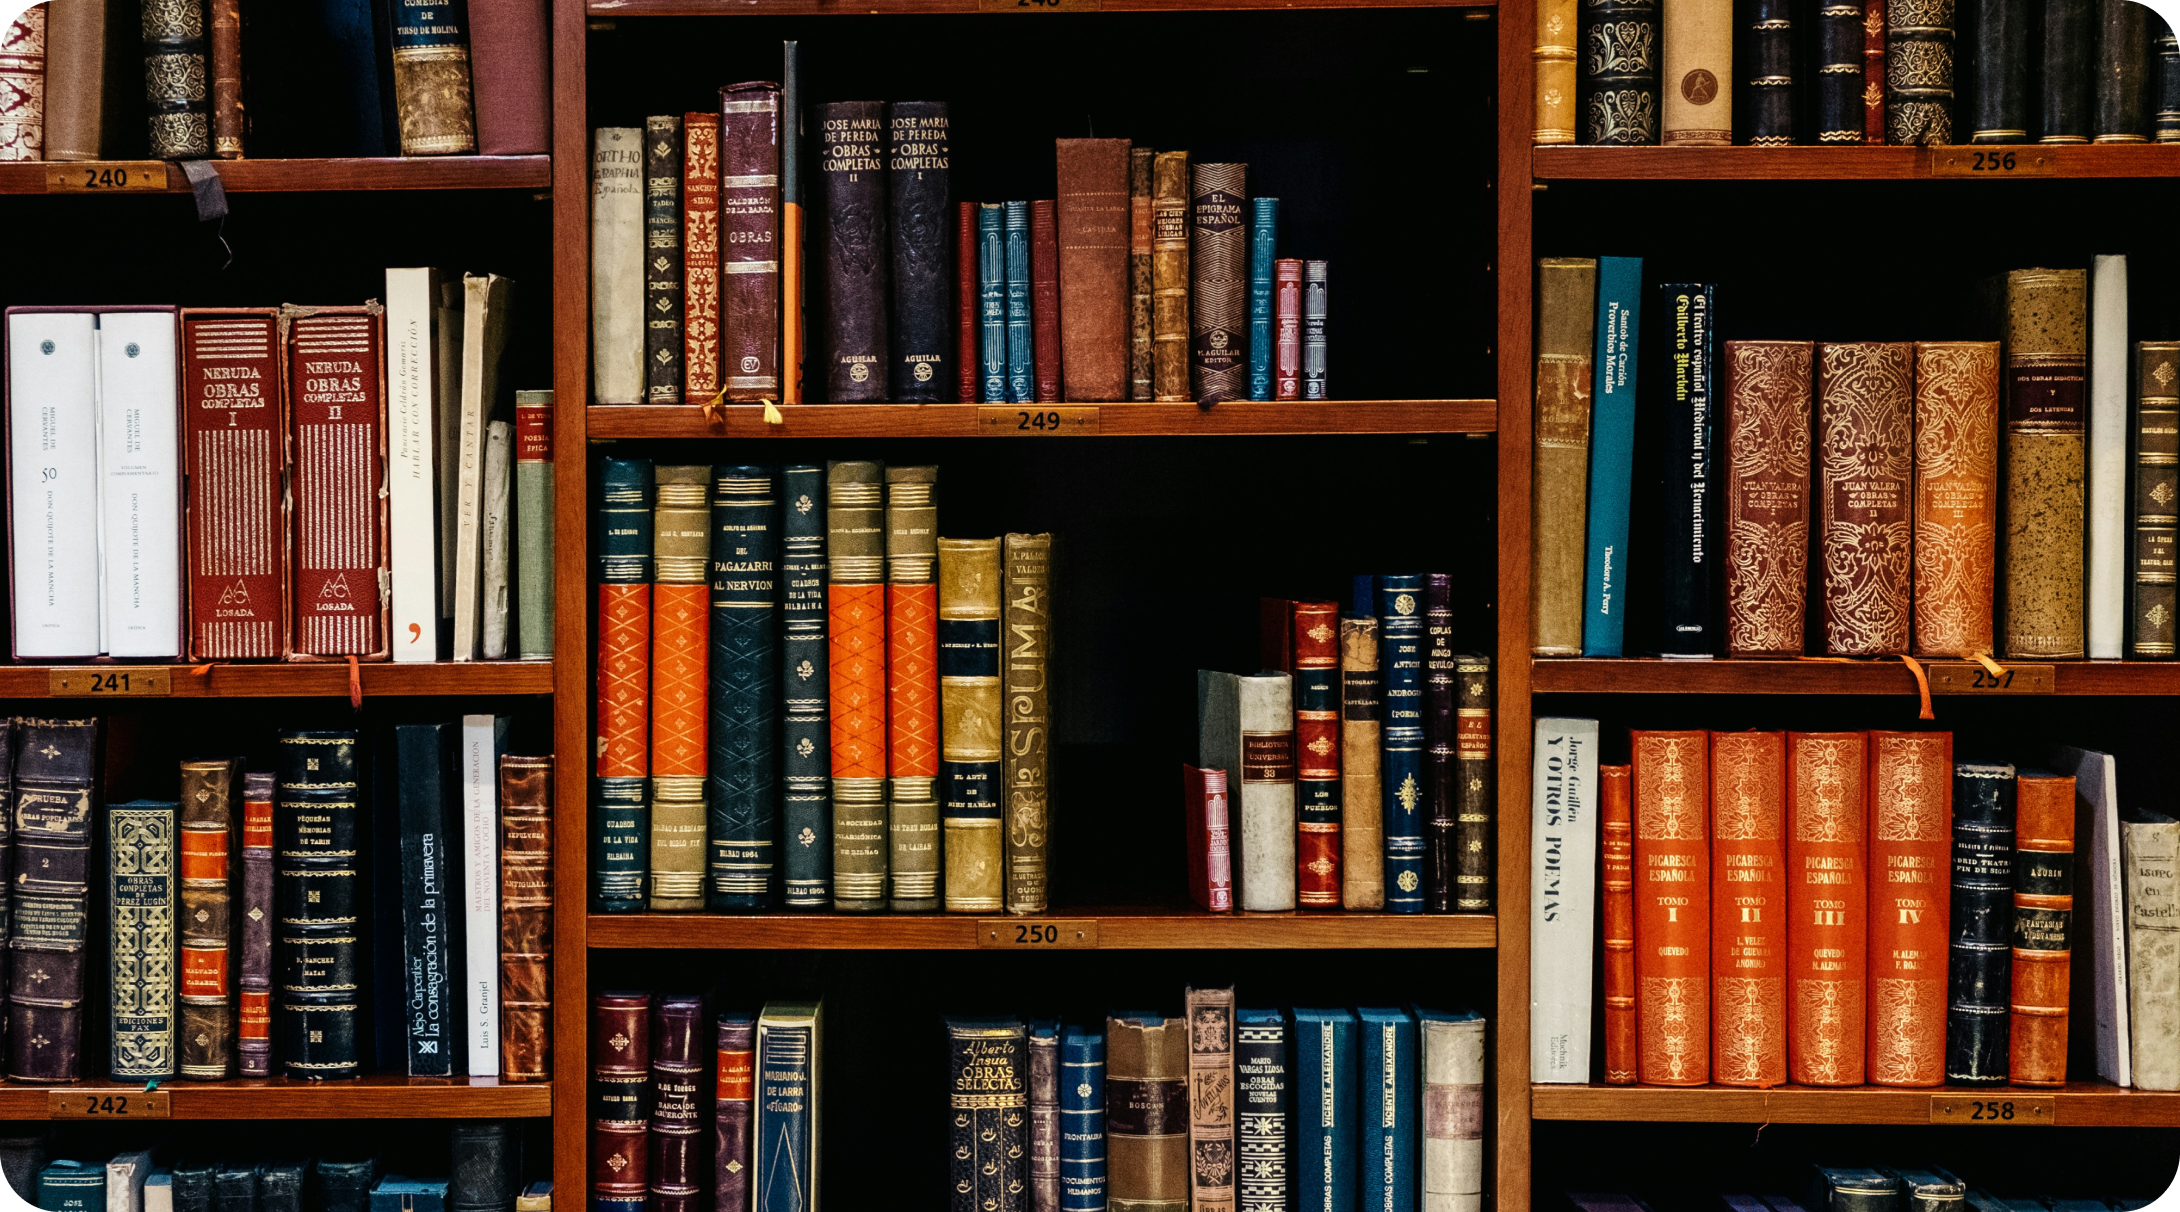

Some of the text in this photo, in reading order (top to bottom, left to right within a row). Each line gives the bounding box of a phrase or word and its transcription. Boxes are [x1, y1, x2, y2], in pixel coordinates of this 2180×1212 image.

[397, 25, 459, 35] TIRSO DE MOLINA
[822, 118, 882, 131] JOSE MARIA
[825, 131, 879, 142] DE PEREDA
[596, 149, 641, 164] ORTHO
[832, 144, 871, 158] OBRAS
[823, 157, 881, 171] COMPLETAS
[1972, 151, 2017, 171] 256
[84, 168, 127, 187] 240
[849, 174, 858, 182] II
[687, 184, 717, 192] SANCHEZ
[727, 196, 771, 206] CALDERÓN
[1212, 194, 1226, 203] EL
[725, 206, 736, 214] DE
[737, 206, 747, 214] LA
[1196, 204, 1241, 215] EPIGRAMA
[1196, 212, 1241, 225] ESPAÑOL
[729, 231, 772, 244] OBRAS
[1693, 294, 1706, 310] El
[1676, 294, 1690, 350] Edilberto
[1693, 312, 1705, 346] teatro
[1605, 301, 1619, 394] Proverbios Morales
[1617, 309, 1630, 387] Santob de Carrión
[841, 355, 878, 363] AGUILAR
[203, 366, 261, 380] NERUDA
[204, 383, 260, 399] OBRAS
[202, 397, 265, 409] COMPLETAS
[407, 318, 421, 480] HABLAR CON CORRECCIÓN
[1018, 412, 1060, 430] 249
[1691, 396, 1706, 450] Medieval
[49, 439, 56, 450] DE
[1691, 451, 1704, 460] y
[42, 467, 57, 483] 50
[1693, 462, 1704, 479] del
[1743, 481, 1802, 491] JUAN VALERA
[1842, 481, 1901, 491] JUAN VALERA
[1760, 492, 1790, 500] OBRAS
[1860, 491, 1889, 500] OBRAS
[1747, 500, 1798, 509] COMPLETAS
[1847, 499, 1897, 508] COMPLETAS
[46, 511, 54, 544] QUIJOTE
[1690, 481, 1706, 564] Renacimiento
[47, 546, 54, 558] DE
[48, 559, 54, 570] LA
[714, 561, 773, 572] PAGAZARRI
[713, 580, 773, 591] AL NERVION
[1600, 545, 1613, 614] Theodore A. Perry
[216, 608, 255, 617] LOSADA
[1429, 626, 1452, 635] COPLAS
[1436, 637, 1445, 647] DE
[1431, 649, 1452, 658] MINGO
[1428, 660, 1454, 669] REVULGO
[91, 673, 130, 692] 241
[1972, 670, 2015, 688] 257
[1249, 741, 1289, 749] BIBLIOTECA
[1263, 769, 1276, 778] 33
[1566, 736, 1582, 823] Jorge Guillén
[472, 741, 483, 913] MAESTROS Y AMIGOS DE LA GENERACION
[1544, 736, 1563, 922] Y OTROS POEMAS
[41, 857, 50, 868] 2
[1648, 854, 1697, 867] PICARESCA
[1726, 854, 1774, 867] PICARESCA
[1805, 856, 1853, 870] PICARESCA
[1887, 855, 1935, 868] PICARESCA
[127, 877, 154, 885] OBRAS
[1649, 868, 1695, 882] ESPAÑOLA
[1727, 868, 1772, 882] ESPAÑOLA
[1806, 870, 1852, 885] ESPAÑOLA
[1888, 869, 1933, 883] ESPAÑOLA
[119, 884, 163, 892] COMPLETAS
[1656, 896, 1689, 906] TOMO
[1735, 896, 1766, 906] TOMO
[1813, 900, 1845, 909] TOMO
[1895, 898, 1926, 909] TOMO
[1667, 907, 1678, 922] I
[1740, 908, 1762, 923] II
[1813, 910, 1845, 926] III
[1899, 909, 1924, 924] IV
[420, 833, 443, 1037] La consagración de la primavera
[1015, 925, 1058, 944] 250
[1658, 946, 1689, 957] QUEVEDO
[1813, 948, 1845, 959] QUEVEDO
[411, 956, 427, 1037] Alejo Carpentier
[478, 980, 490, 1050] Luis S. Granjel
[963, 1040, 1016, 1055] Alberto
[970, 1054, 1008, 1066] Insua
[1250, 1057, 1272, 1065] MARIO
[764, 1070, 799, 1081] MARIANO
[799, 1071, 807, 1082] J.
[962, 1066, 1014, 1079] OBRAS
[1239, 1065, 1285, 1074] VARGAS LLOSA
[1323, 1025, 1332, 1127] VICENTE ALEIXANDRE
[956, 1077, 1022, 1091] SELECTAS
[1250, 1076, 1275, 1084] OBRAS
[674, 1084, 696, 1092] TORRES
[767, 1087, 804, 1097] DE LARRA
[87, 1096, 129, 1113] 242
[658, 1101, 696, 1110] BARCA DE
[1971, 1102, 2015, 1120] 258
[1323, 1135, 1332, 1212] OBRAS COMPLETAS
